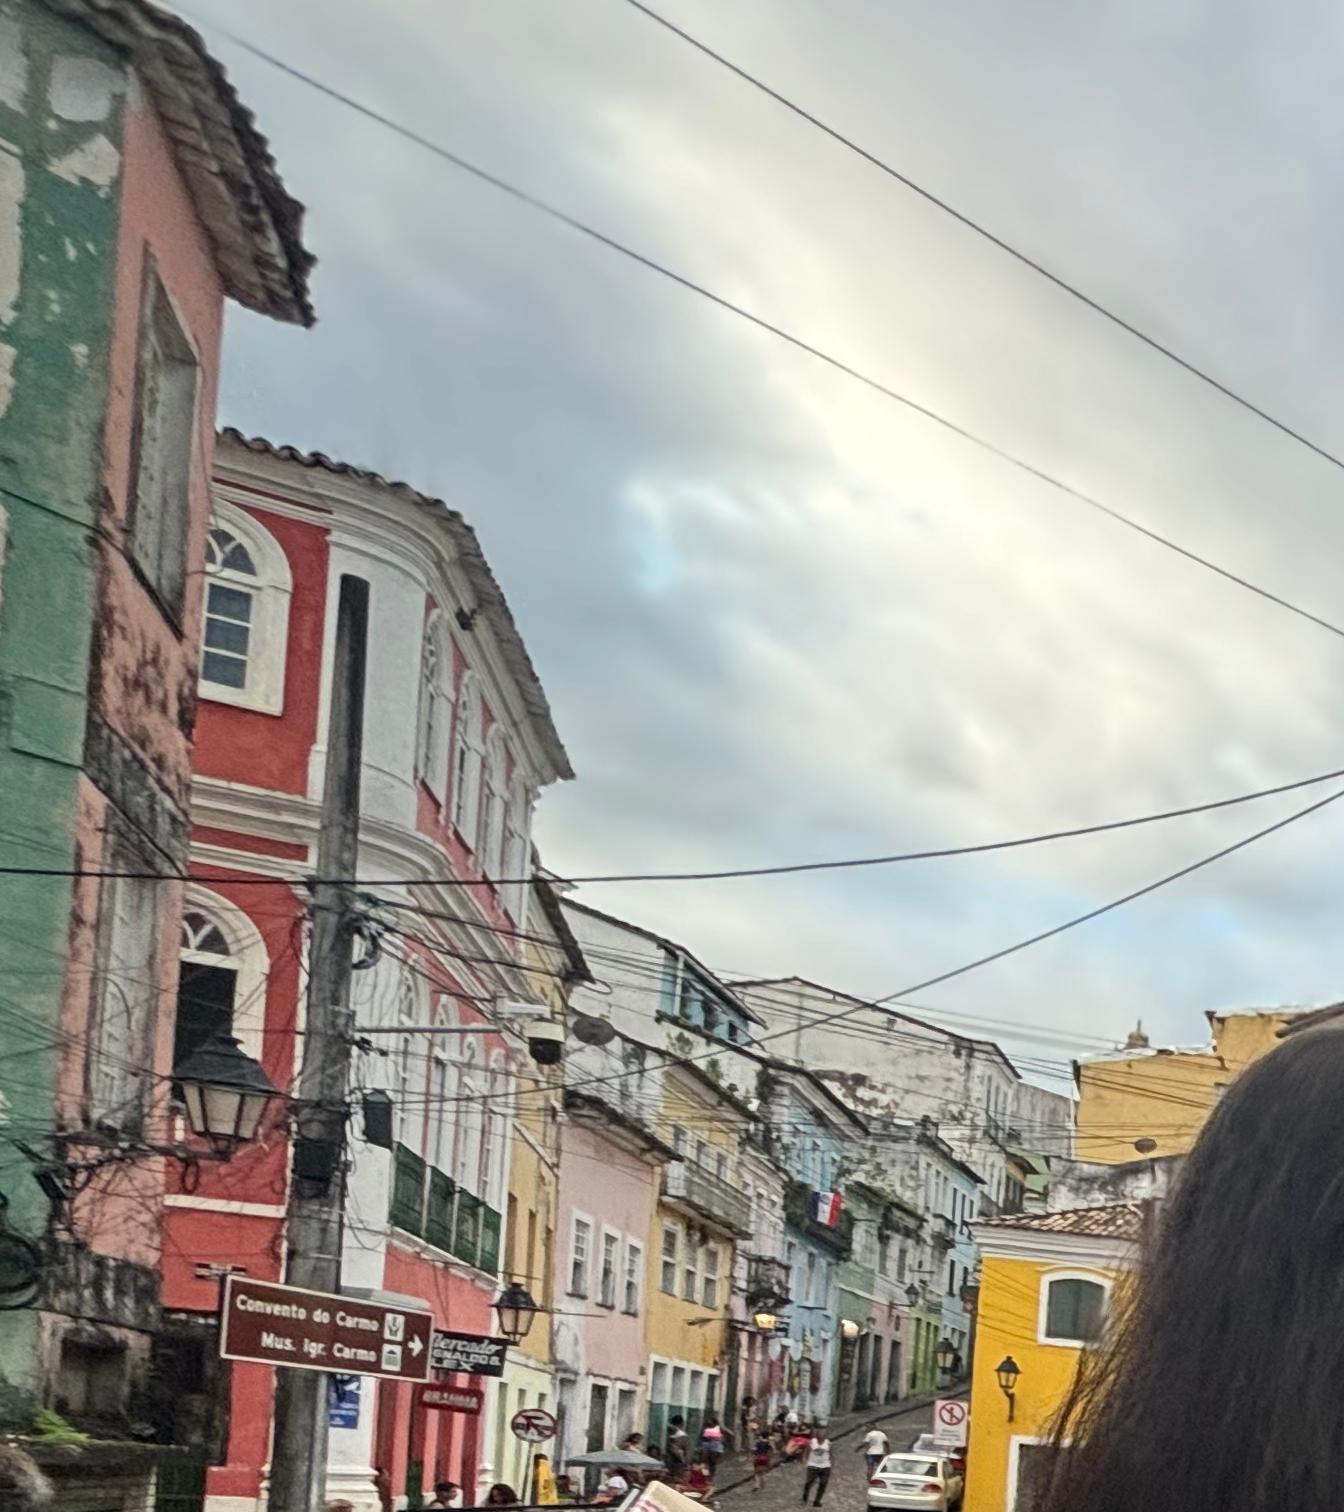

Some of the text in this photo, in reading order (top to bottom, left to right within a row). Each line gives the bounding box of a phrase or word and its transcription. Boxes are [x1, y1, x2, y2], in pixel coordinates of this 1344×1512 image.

[235, 1294, 379, 1332] Convento do Carmo
[261, 1331, 296, 1352] Mus.
[333, 1342, 377, 1363] Carmo
[431, 1357, 473, 1372] LEX
